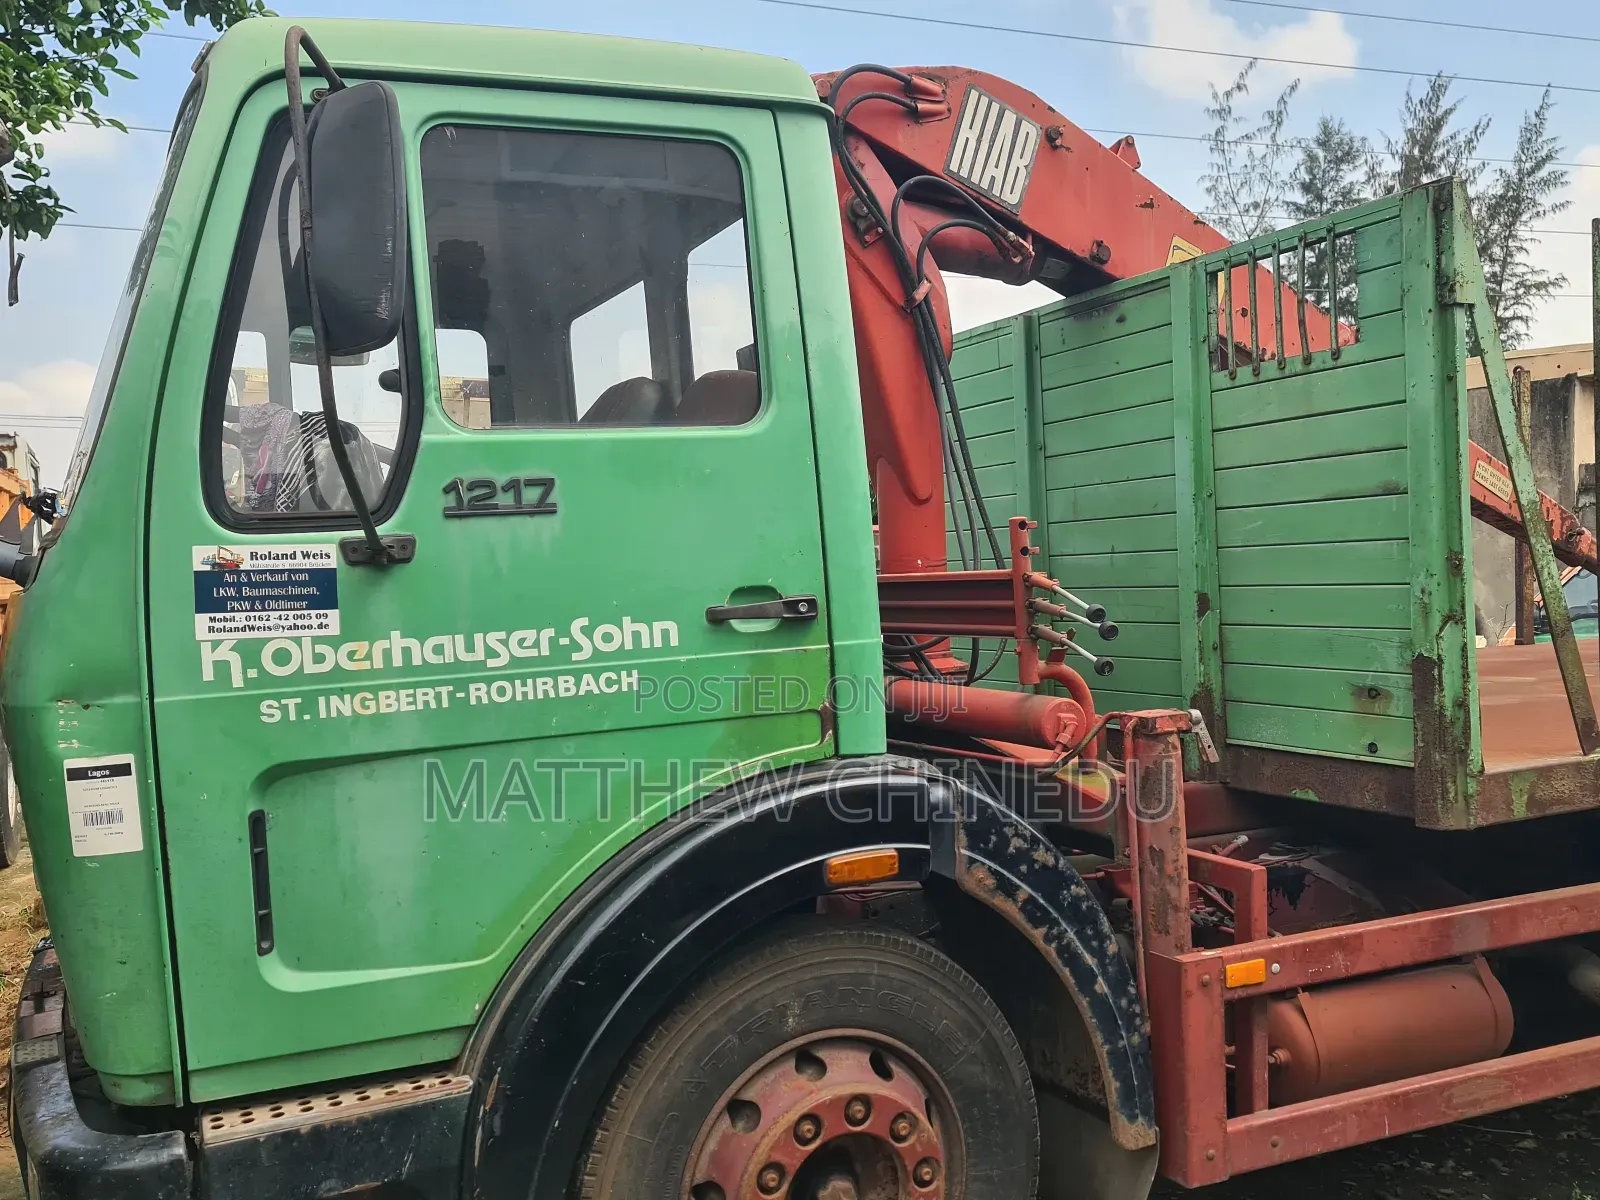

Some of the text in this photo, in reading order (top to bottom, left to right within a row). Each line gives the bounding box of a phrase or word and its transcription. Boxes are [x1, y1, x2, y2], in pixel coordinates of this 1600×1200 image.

[949, 88, 1039, 206] HIAB
[443, 476, 556, 511] 1217
[249, 549, 331, 561] Roland Weis
[223, 571, 309, 583] An & Verkauf von
[213, 585, 320, 598] LKW, Baumaschinen,
[227, 599, 308, 611] PKW & Oldtimer
[208, 615, 242, 624] Mobil.:
[245, 614, 271, 622] 0162
[292, 613, 313, 621] 005
[315, 612, 329, 620] 09
[207, 621, 330, 634] RolandWeis@yahoo.de
[259, 669, 640, 724] ST. INGBERT-ROHRBACH
[87, 769, 110, 778] Lagos
